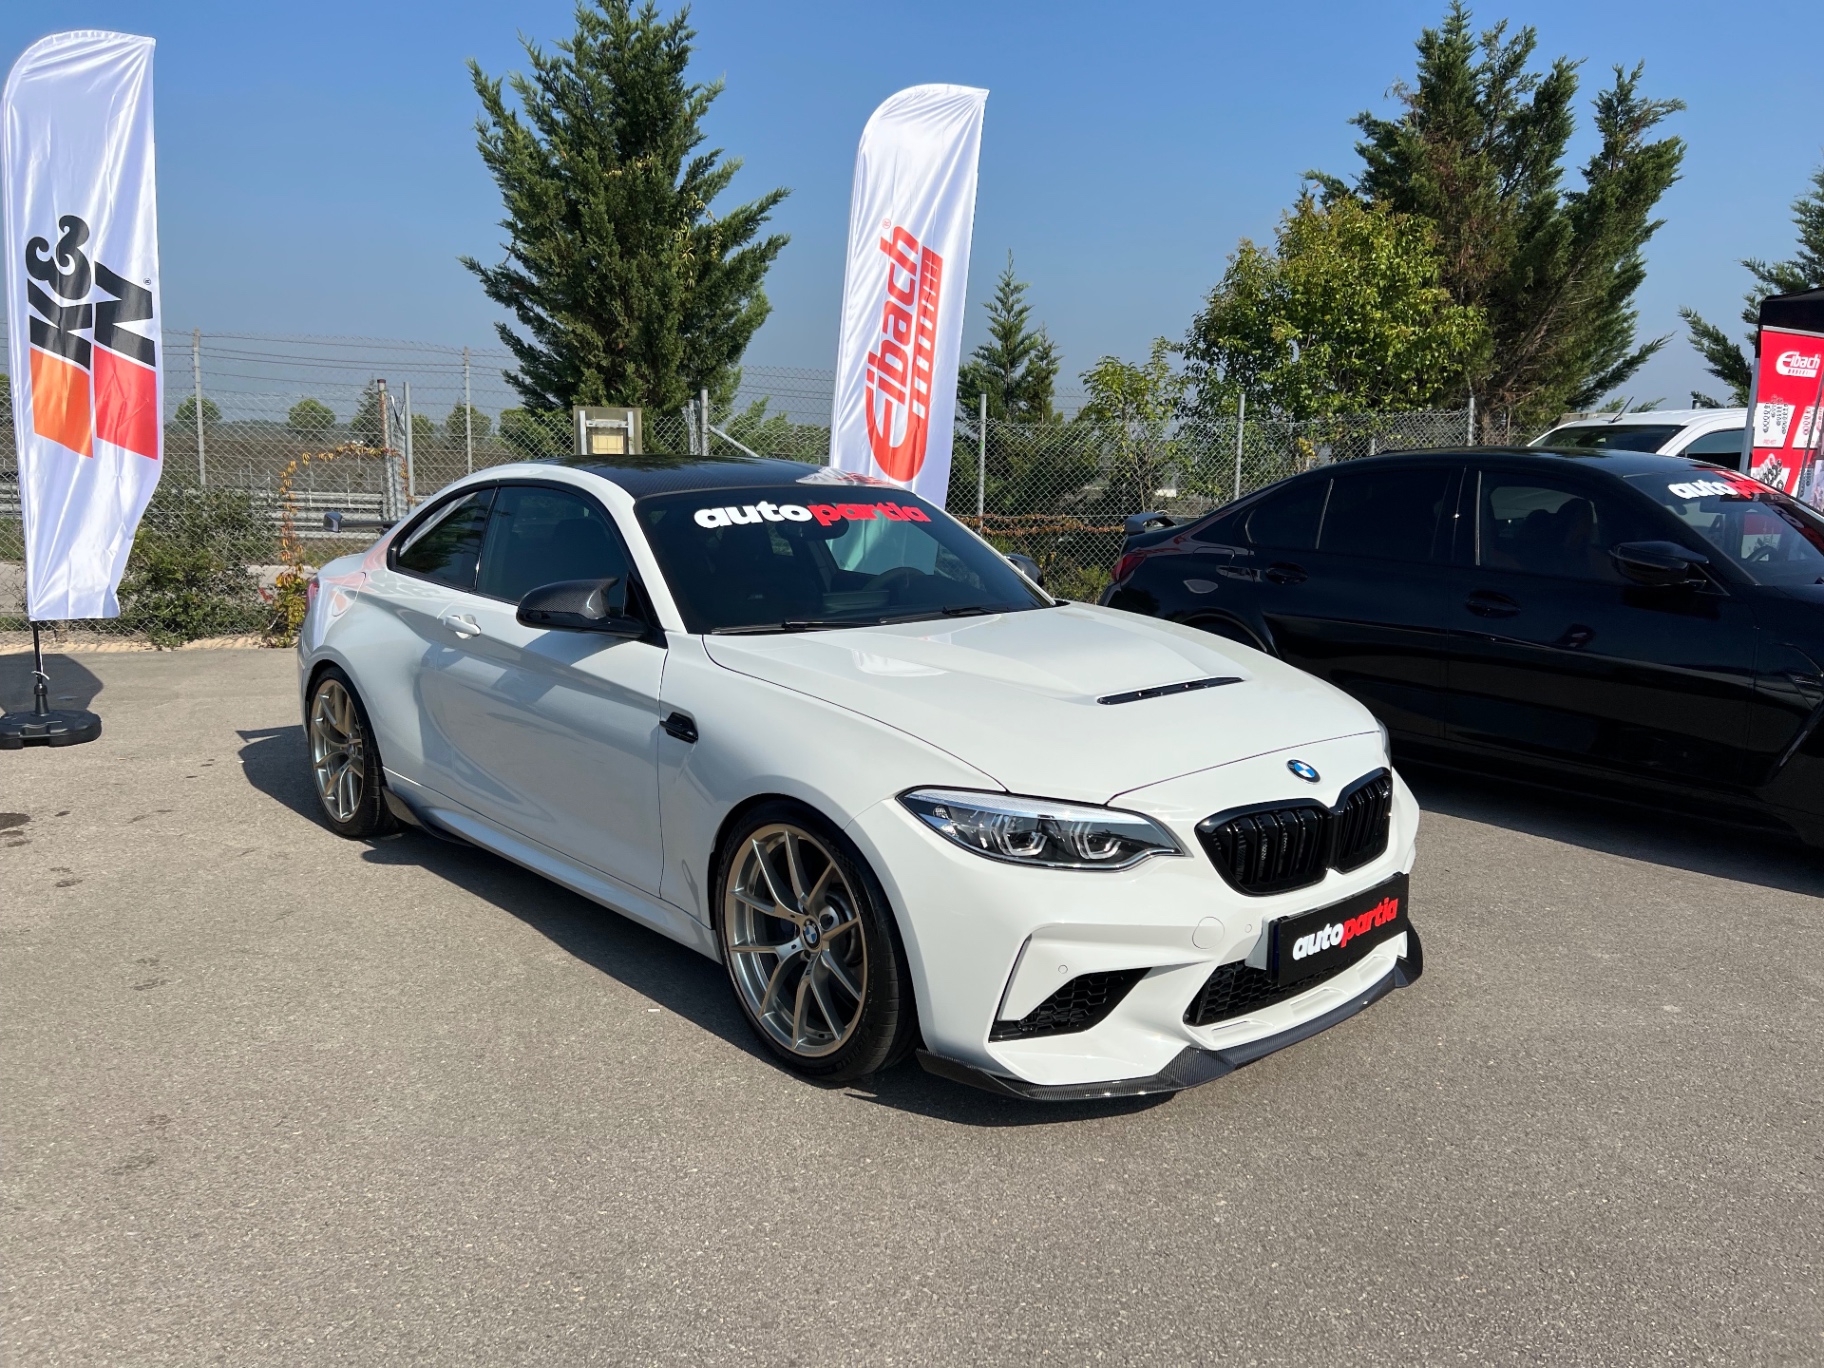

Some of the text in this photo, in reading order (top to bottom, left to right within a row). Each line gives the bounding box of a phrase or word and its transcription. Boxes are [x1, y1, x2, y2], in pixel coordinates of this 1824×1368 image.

[25, 214, 156, 371] K&N
[694, 501, 932, 528] autopartia
[1292, 897, 1399, 960] autopartia
